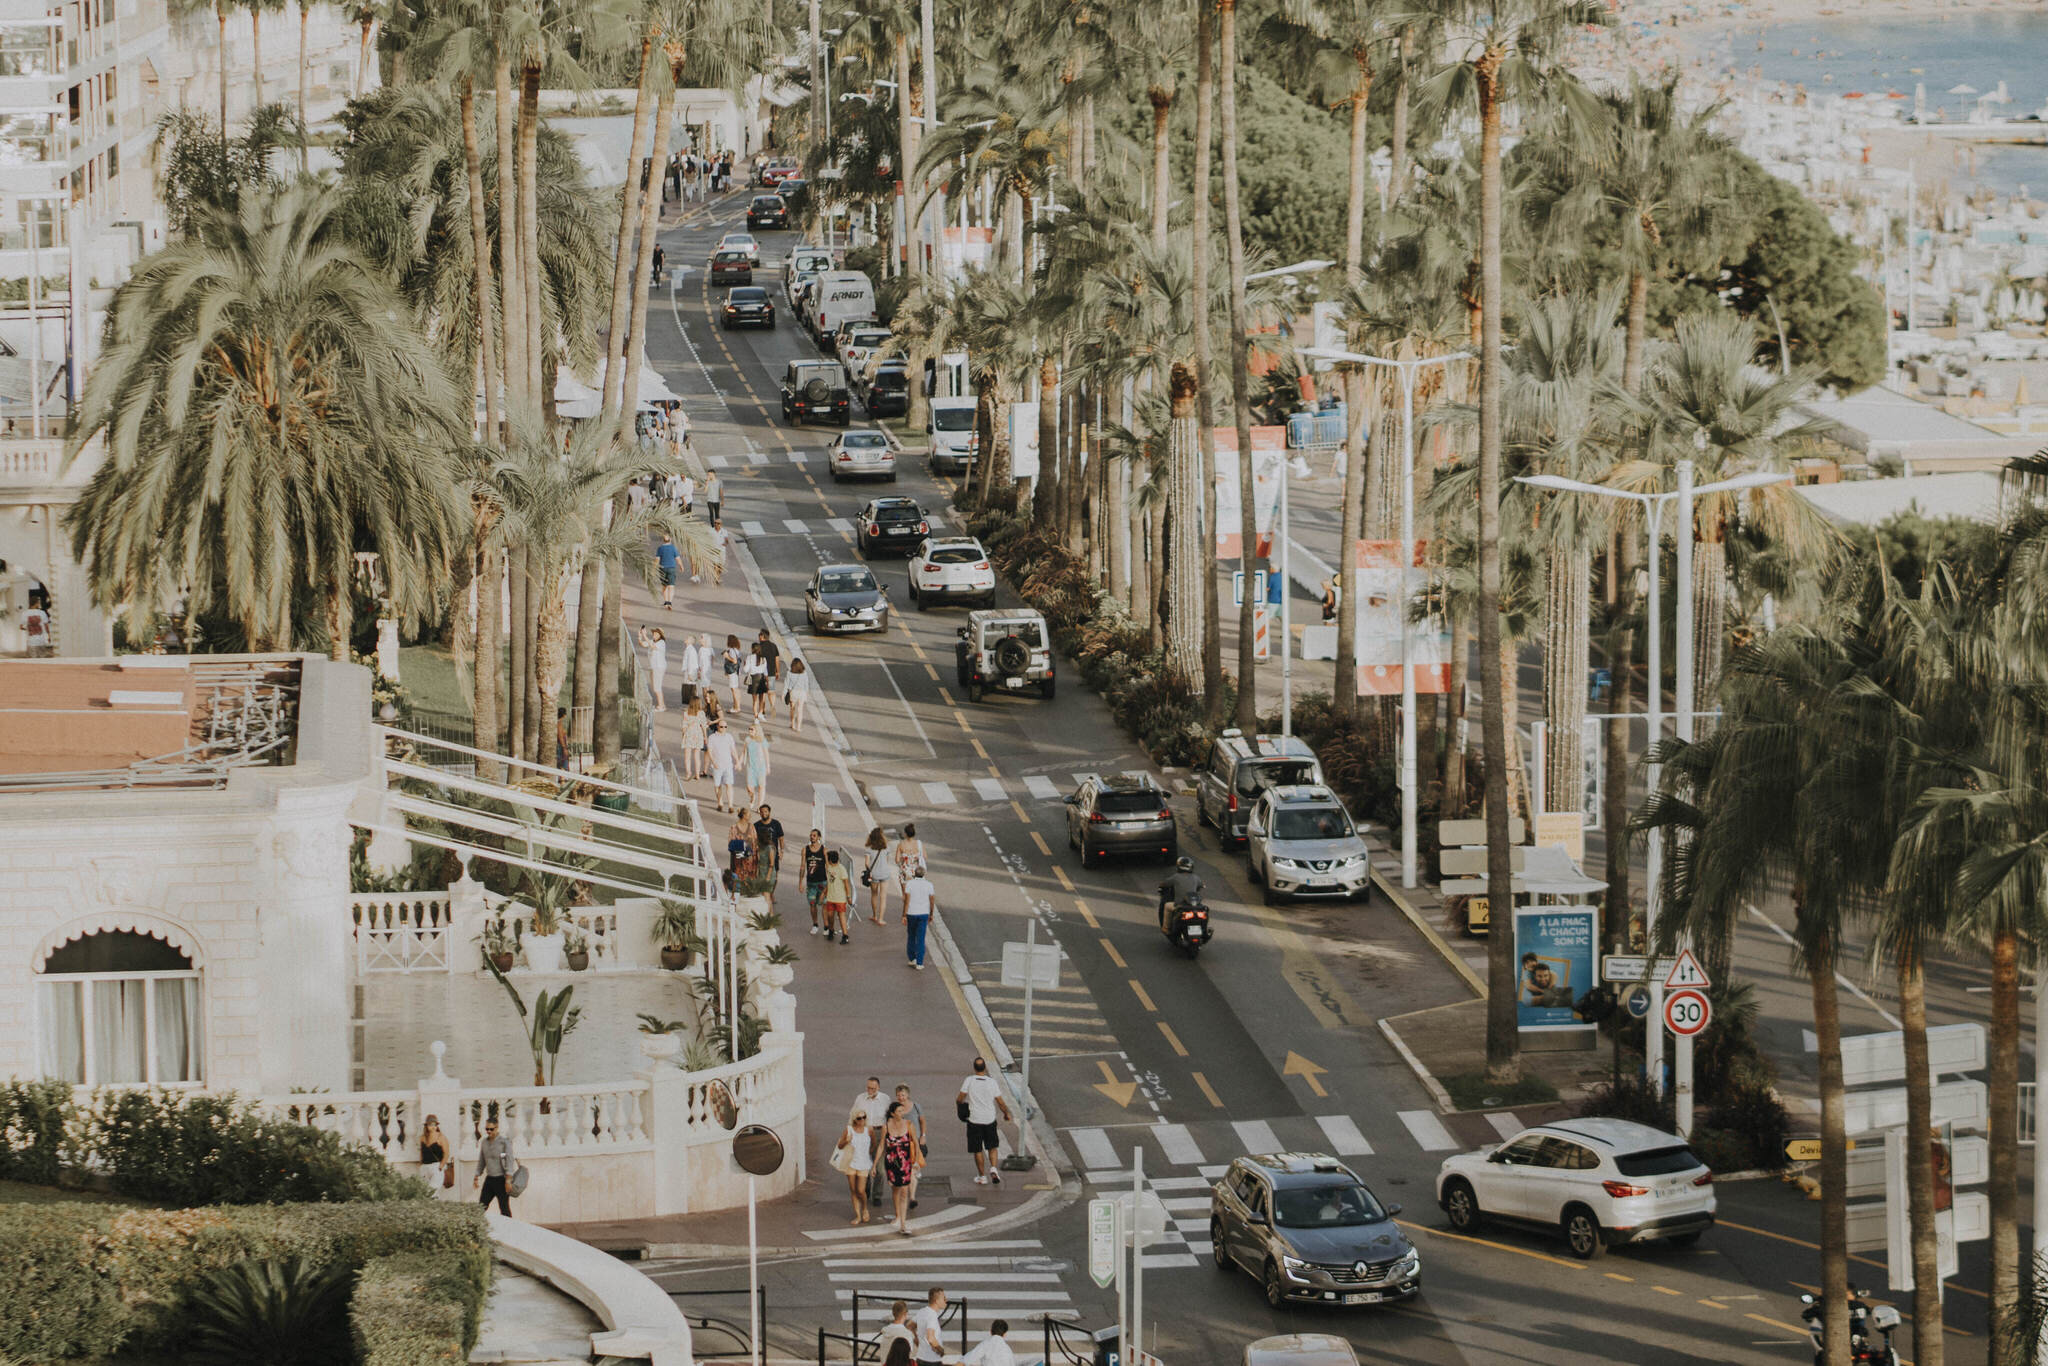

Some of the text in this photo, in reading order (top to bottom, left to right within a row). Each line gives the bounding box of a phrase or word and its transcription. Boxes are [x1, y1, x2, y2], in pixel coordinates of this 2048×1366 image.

[831, 291, 864, 301] ARNDT
[1477, 902, 1488, 910] TA
[1538, 916, 1546, 926] À
[1548, 918, 1560, 926] LA
[1540, 926, 1589, 936] À CHACUN
[1553, 937, 1589, 946] SON PC
[1674, 1003, 1701, 1022] 30
[1109, 1353, 1119, 1366] P
